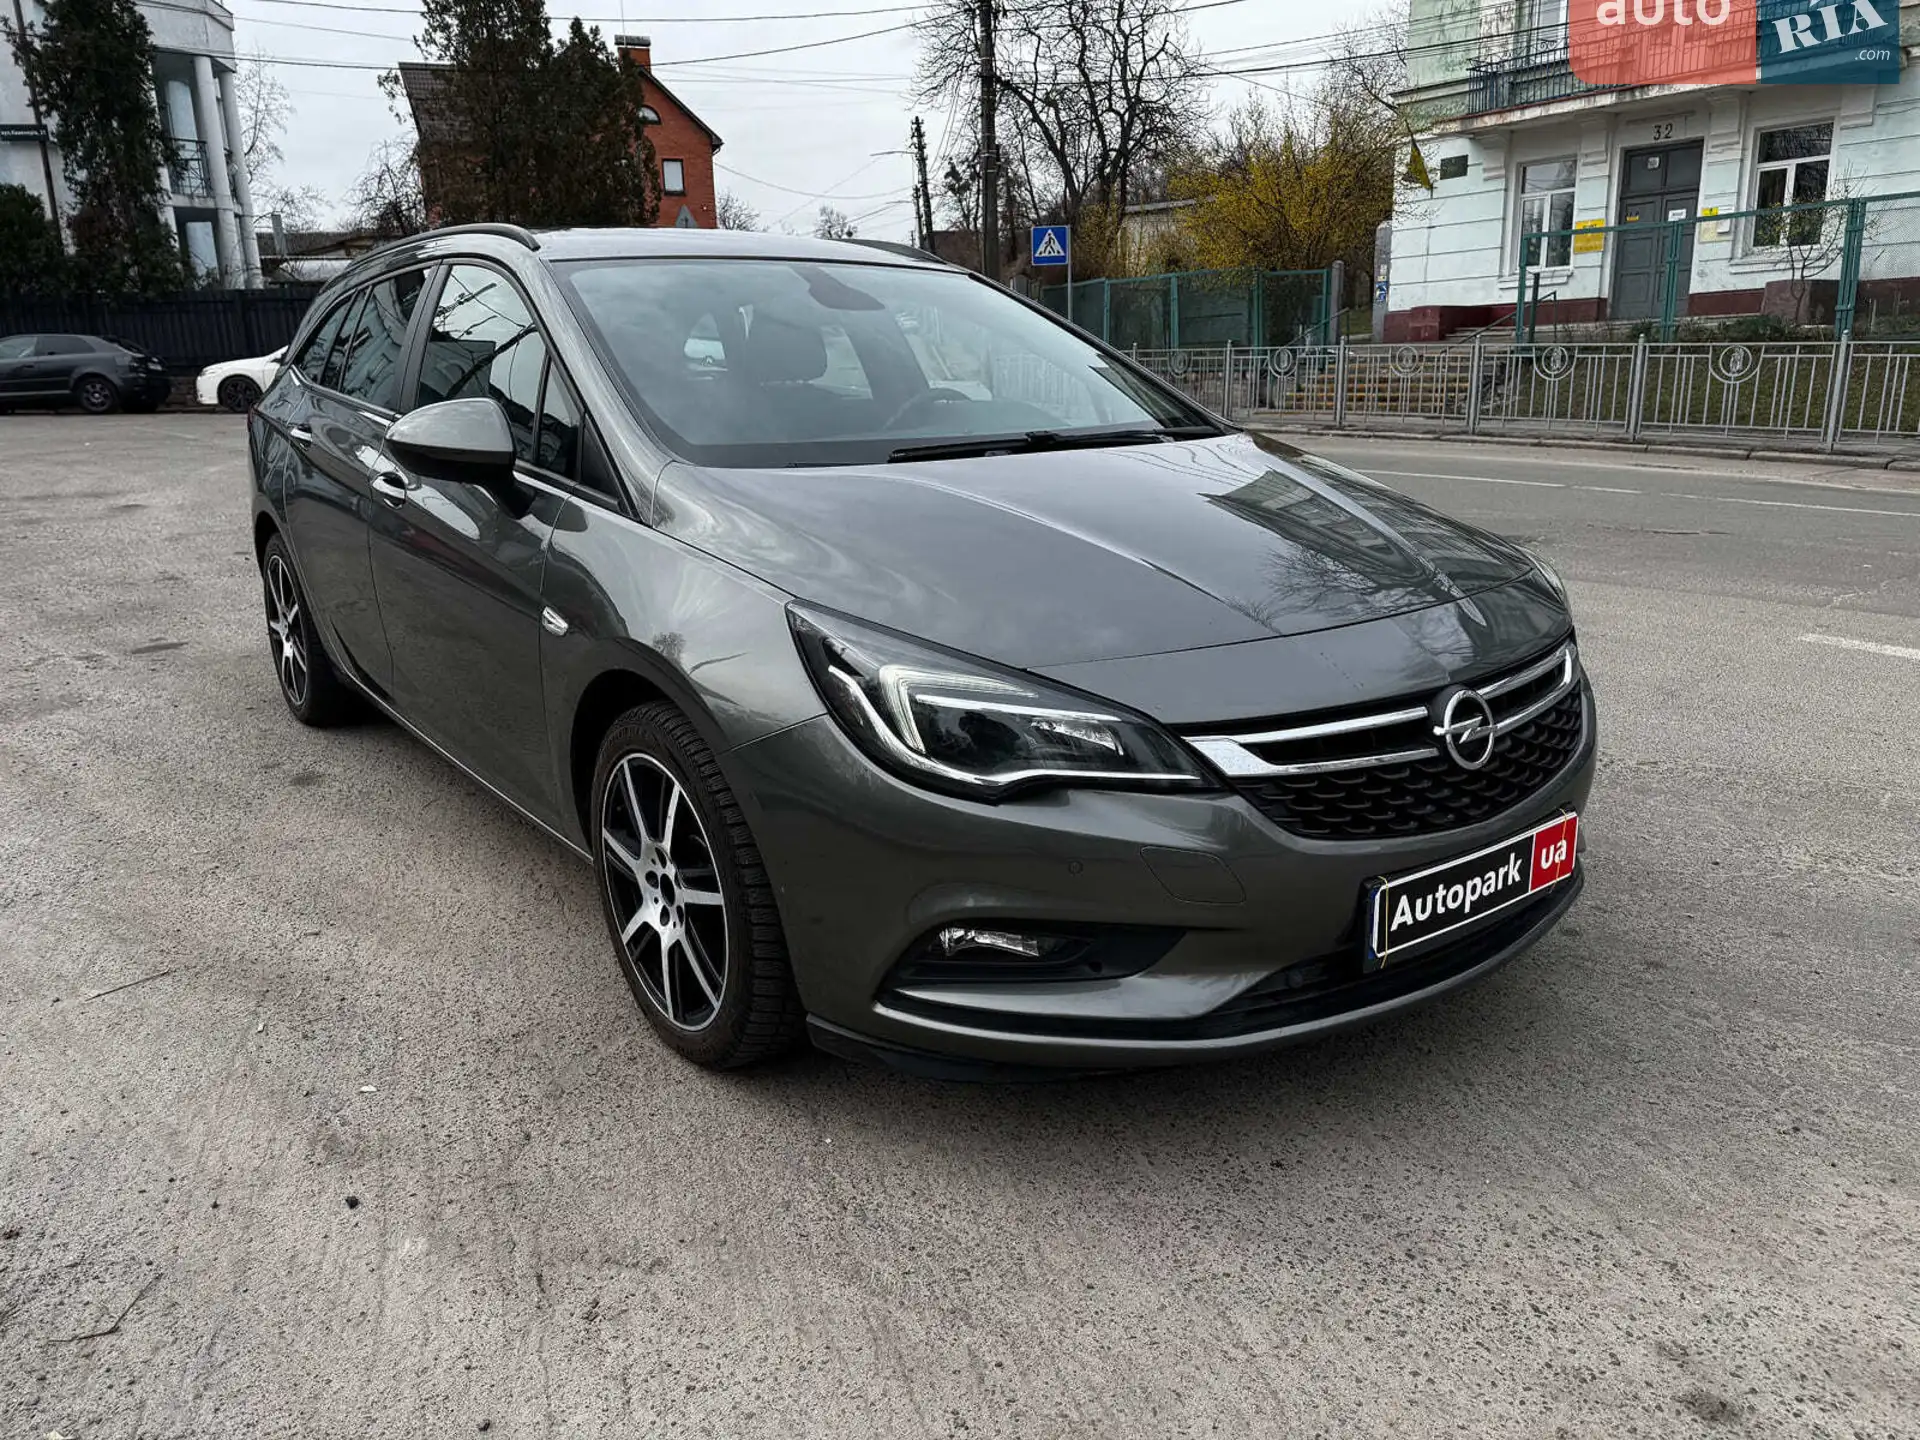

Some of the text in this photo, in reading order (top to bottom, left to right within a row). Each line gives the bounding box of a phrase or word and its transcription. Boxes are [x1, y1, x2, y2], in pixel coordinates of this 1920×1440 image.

[1653, 123, 1673, 140] 32
[1390, 839, 1567, 932] Autopark ua
